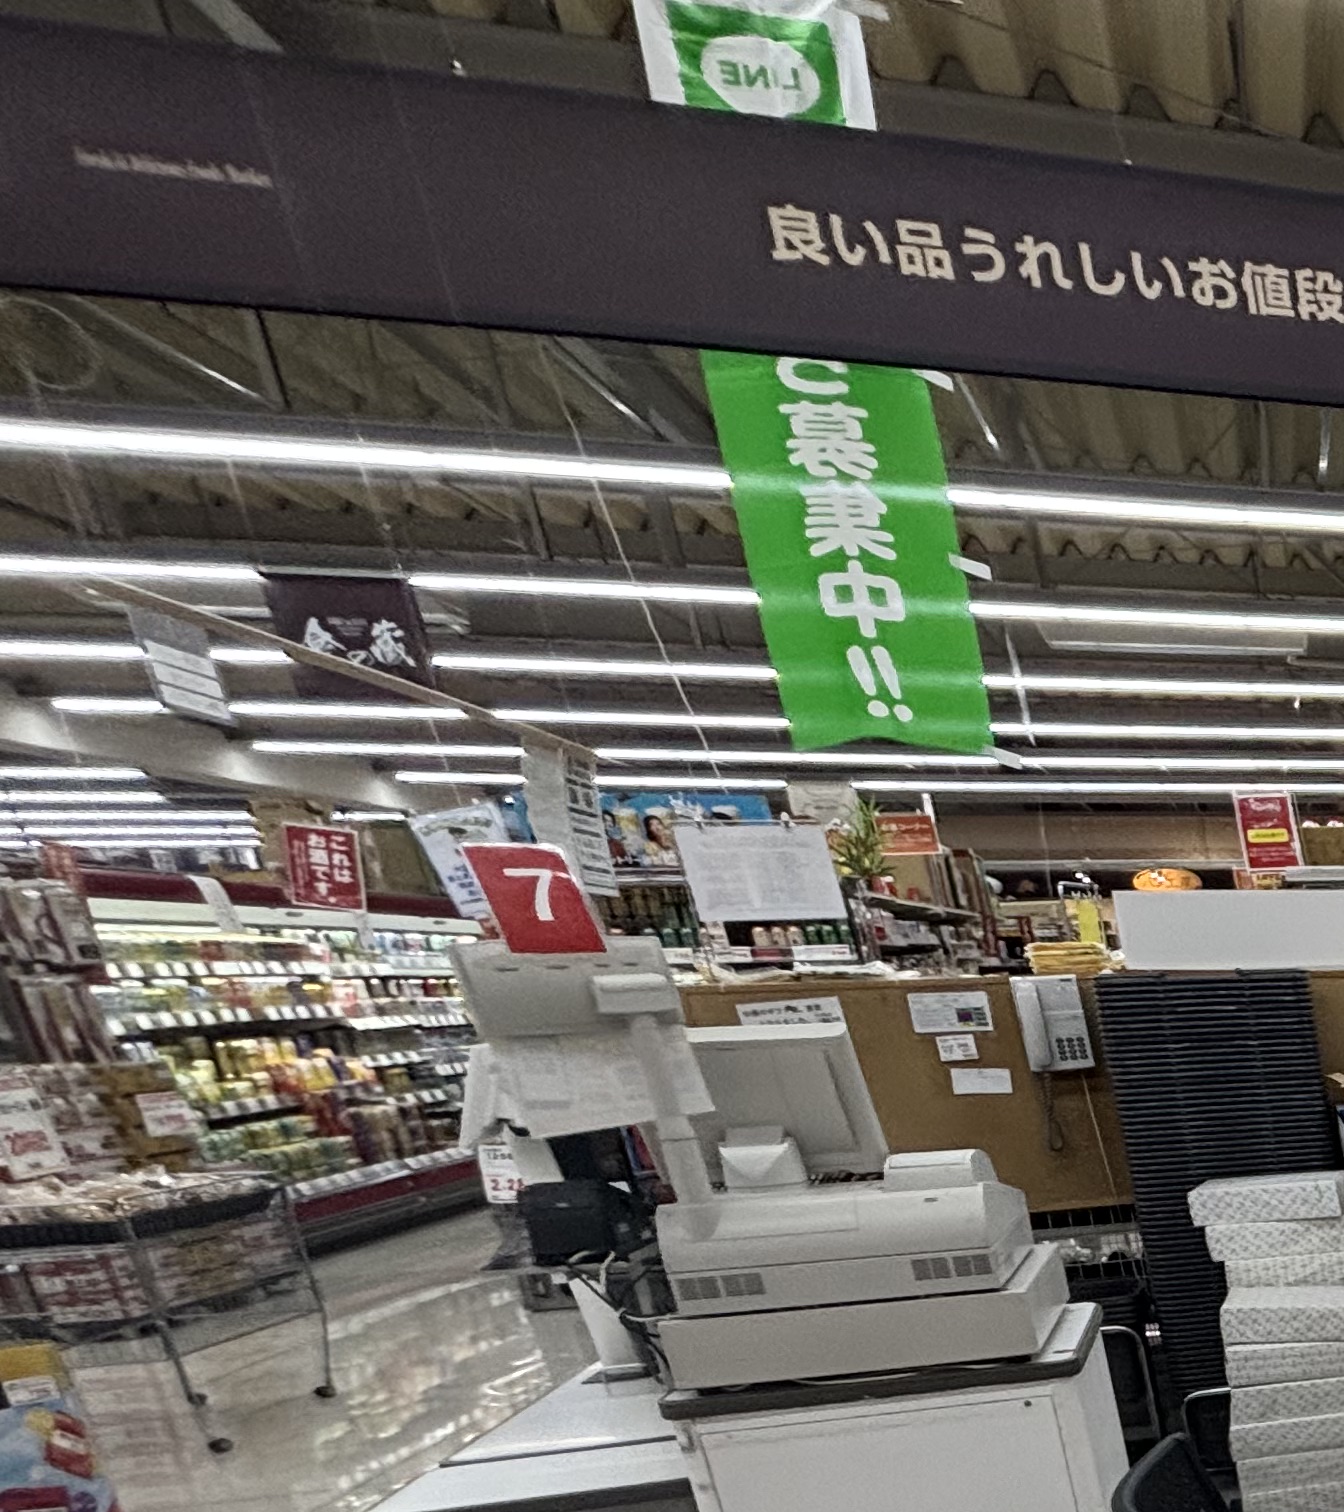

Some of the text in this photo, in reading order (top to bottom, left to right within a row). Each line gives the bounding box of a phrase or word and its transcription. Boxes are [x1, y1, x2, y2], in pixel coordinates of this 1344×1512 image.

[329, 834, 355, 884] これは
[503, 867, 556, 922] 7
